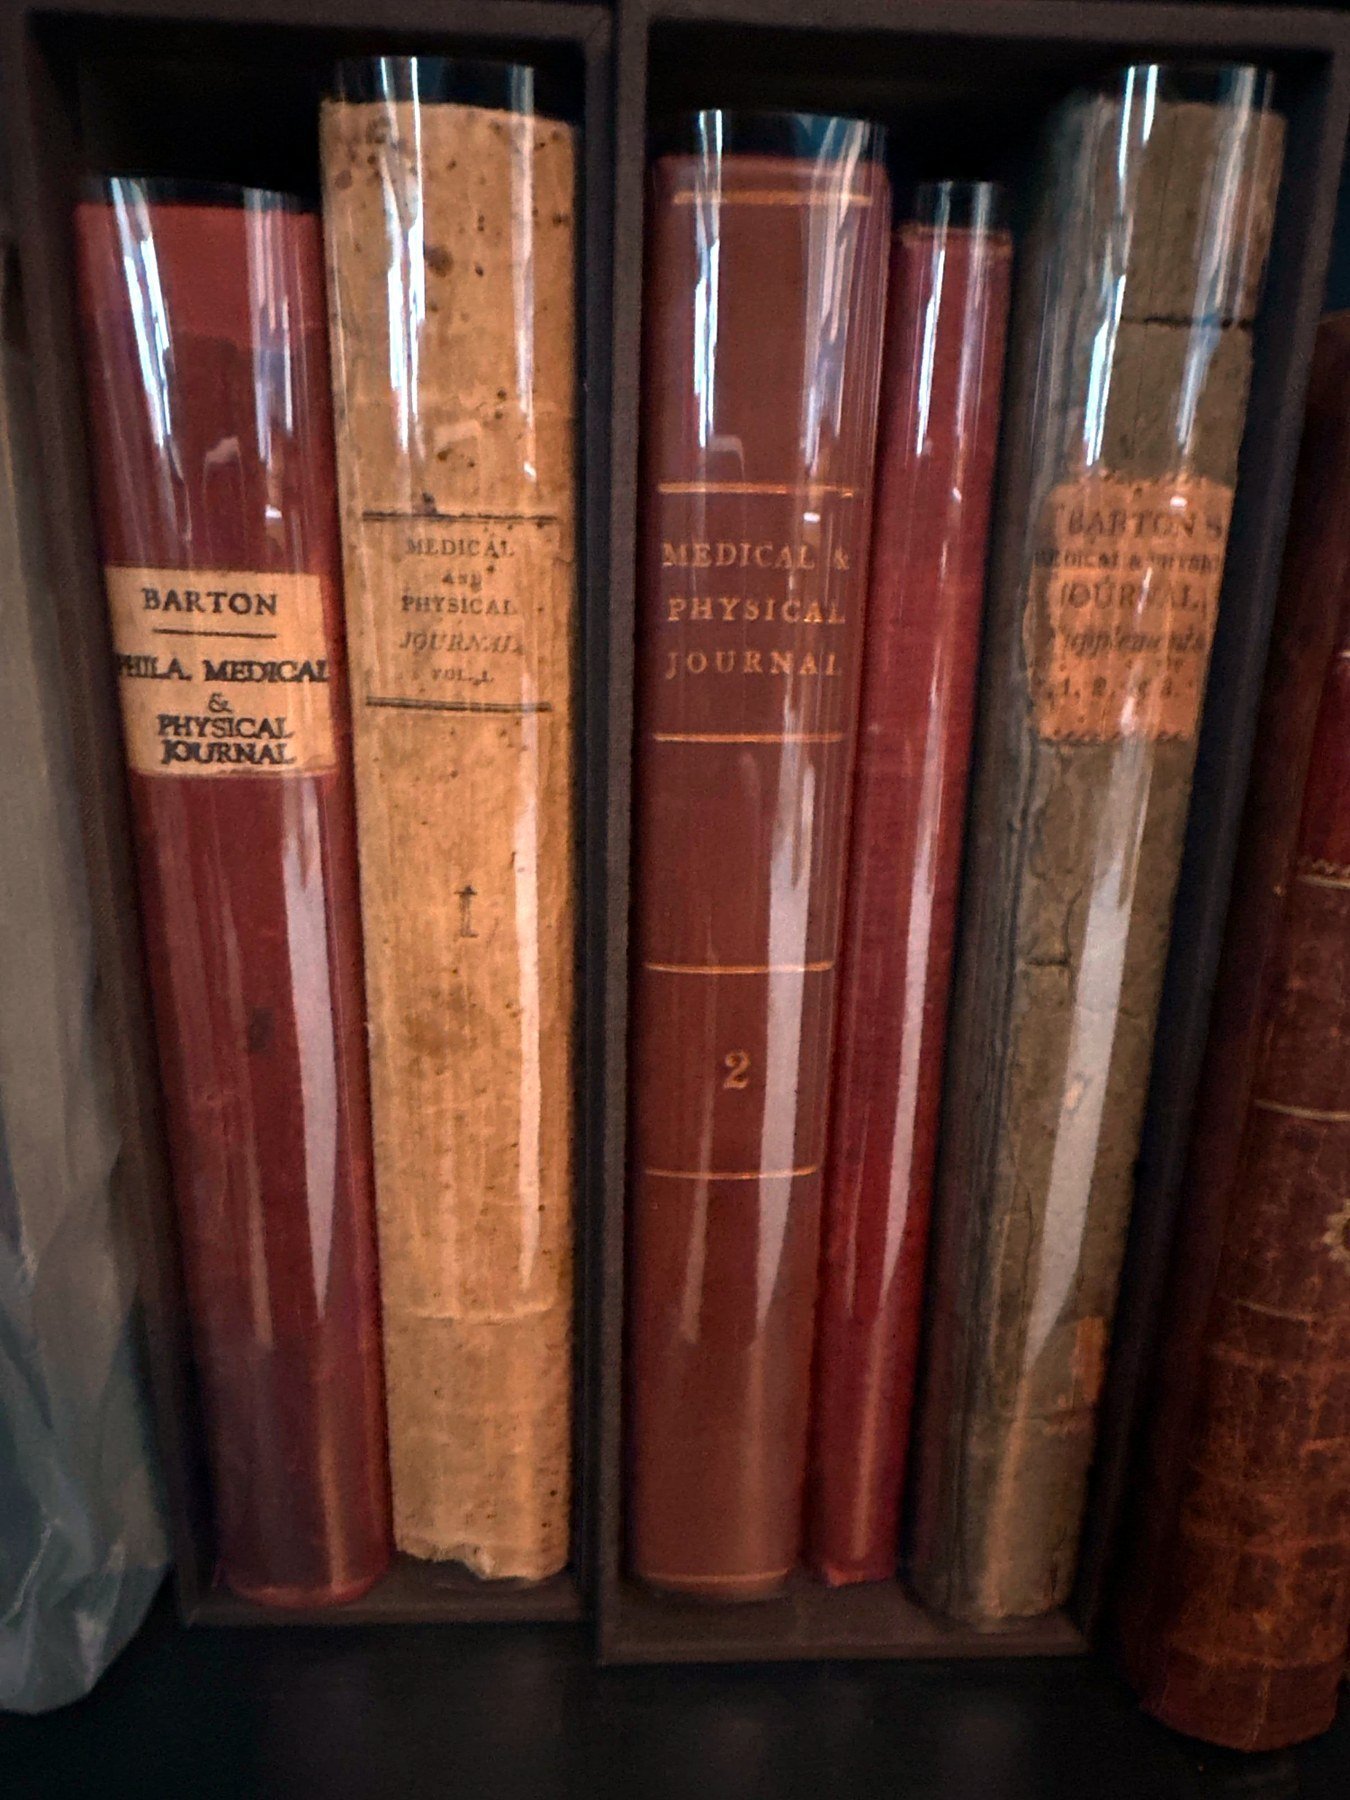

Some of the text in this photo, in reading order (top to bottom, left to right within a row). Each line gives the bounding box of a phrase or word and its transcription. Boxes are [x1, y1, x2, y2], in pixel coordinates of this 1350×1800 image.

[407, 539, 515, 557] MEDICAL
[662, 542, 850, 570] MEDICAL &
[142, 587, 277, 615] BARTON
[401, 595, 517, 616] PHYSICAL
[668, 597, 846, 625] PHYSICAL
[400, 632, 523, 655] JOURNAL
[202, 659, 328, 683] MEDICAL
[666, 651, 841, 680] JOURNAL
[208, 692, 232, 713] &
[157, 714, 294, 739] PHYSICAL
[161, 740, 297, 765] JOURNAL
[724, 1051, 750, 1089] 2
